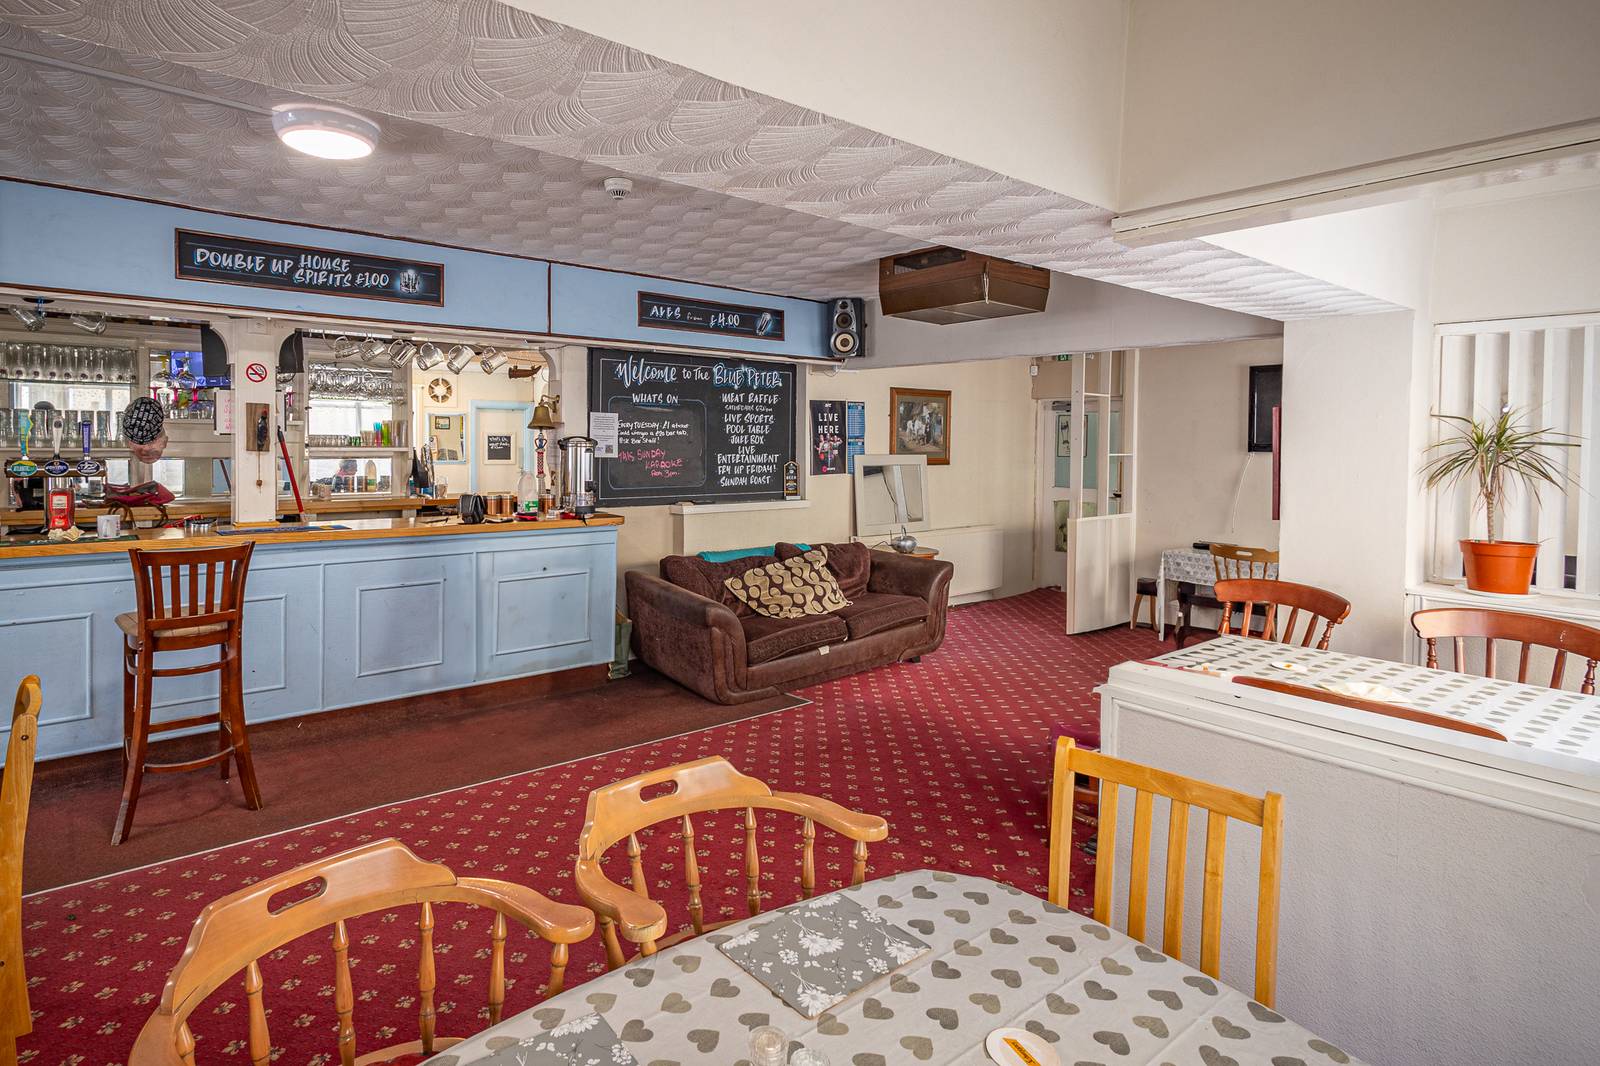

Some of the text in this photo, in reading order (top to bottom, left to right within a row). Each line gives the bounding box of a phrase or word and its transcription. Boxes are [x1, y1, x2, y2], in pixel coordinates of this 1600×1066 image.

[195, 248, 294, 275] DOUBLE UP
[299, 253, 351, 272] HOUSE
[293, 268, 353, 288] SPIRITS
[649, 305, 682, 320] ALES
[709, 312, 740, 328] £4.00
[615, 355, 678, 388] Welcome
[682, 367, 692, 379] to
[693, 366, 710, 380] The
[632, 393, 679, 403] WHATS ON
[722, 392, 779, 404] MEAT RAFFLE
[724, 412, 775, 424] LIVE SPORTS
[818, 413, 839, 422] LIVE
[726, 424, 771, 434] POOL TABLE
[818, 425, 839, 434] HERE
[730, 434, 765, 445] JUKE BOX
[637, 448, 666, 461] SUNDAY
[738, 445, 756, 454] LIVE
[717, 453, 780, 465] ENTERTAINMENT
[718, 465, 732, 475] FRY
[734, 464, 745, 474] UP
[746, 464, 777, 475] FRIDAY!
[720, 475, 771, 487] SUNDAY ROAST
